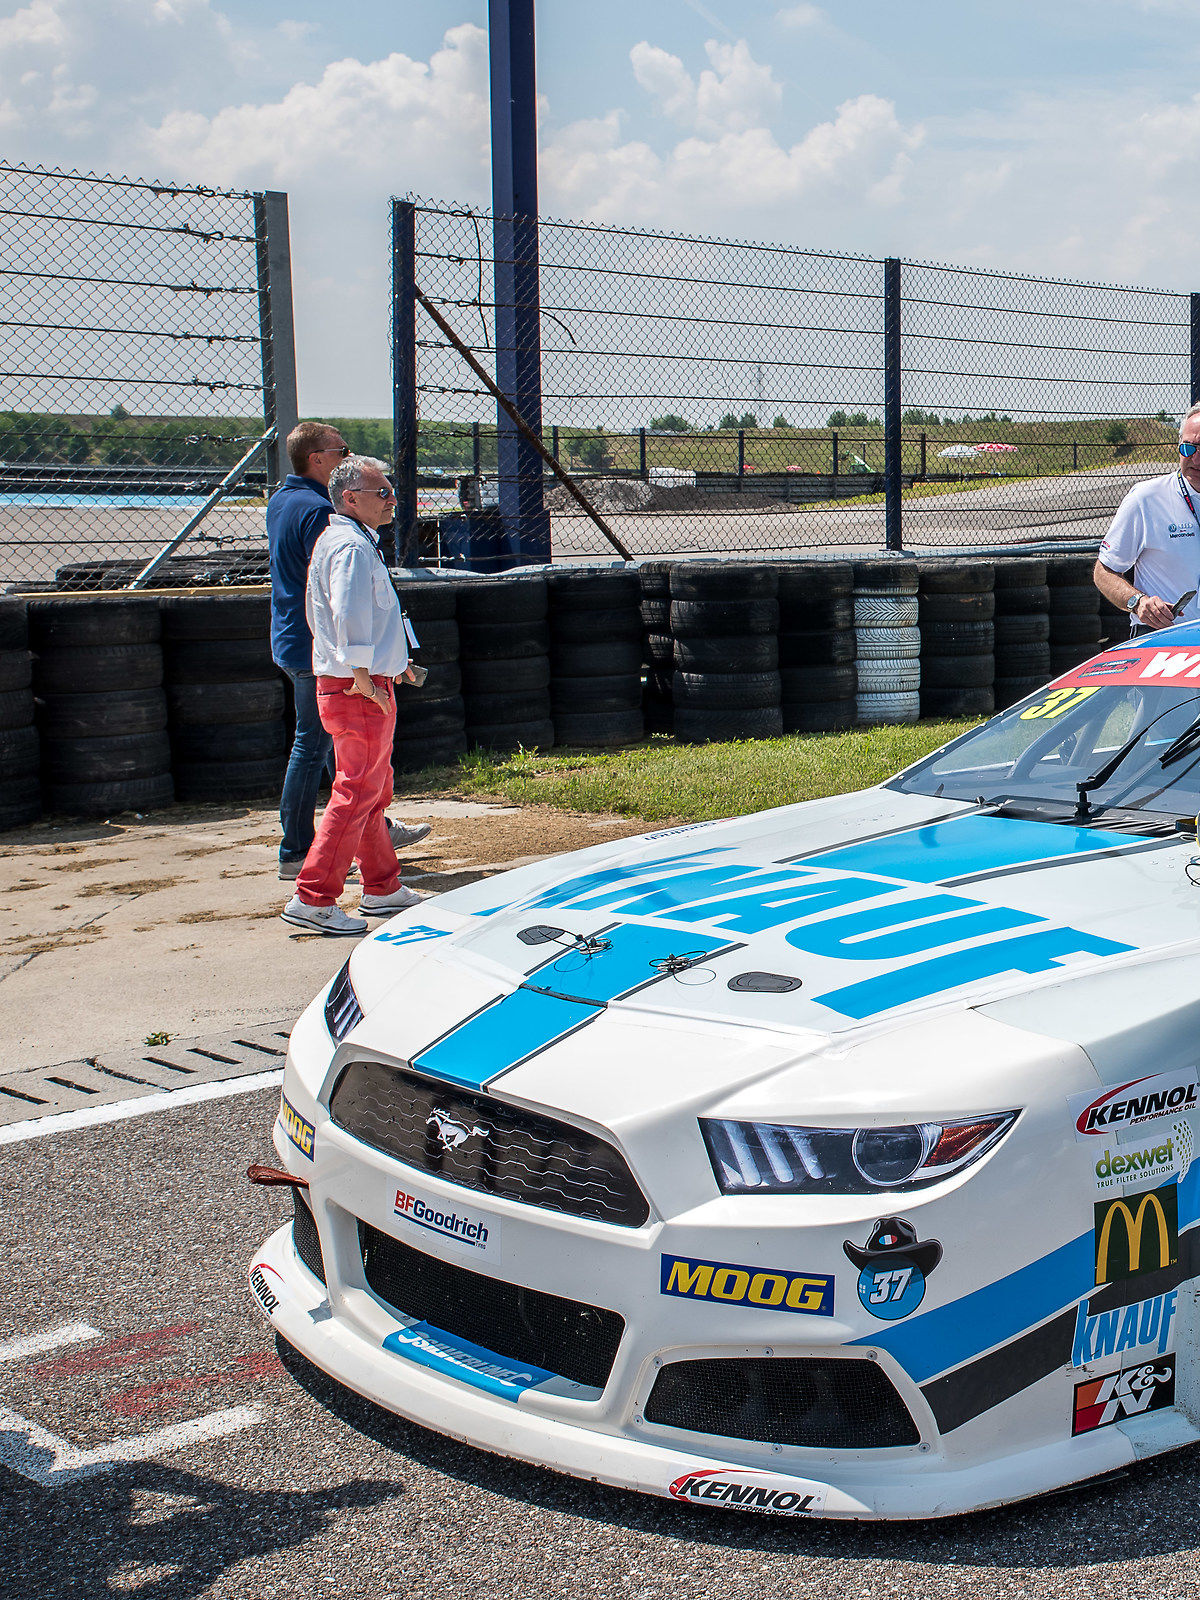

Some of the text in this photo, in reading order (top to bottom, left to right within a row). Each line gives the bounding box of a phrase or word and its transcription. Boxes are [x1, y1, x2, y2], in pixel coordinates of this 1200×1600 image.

[1020, 686, 1101, 720] 37
[373, 925, 453, 946] 37
[471, 847, 1140, 1020] KNAUF
[1086, 1083, 1198, 1130] KENNOL
[1129, 1103, 1197, 1125] PERFORMANCE OIL
[1095, 1138, 1175, 1179] dexwet
[1096, 1164, 1174, 1189] TRUE FILTER SOLUTIONS
[393, 1189, 489, 1243] BFGoodrich
[249, 1267, 280, 1316] KENNOL
[666, 1260, 827, 1311] MOOG
[869, 1266, 915, 1305] 37
[1072, 1289, 1179, 1368] KNAUF
[677, 1477, 816, 1514] KENNOL
